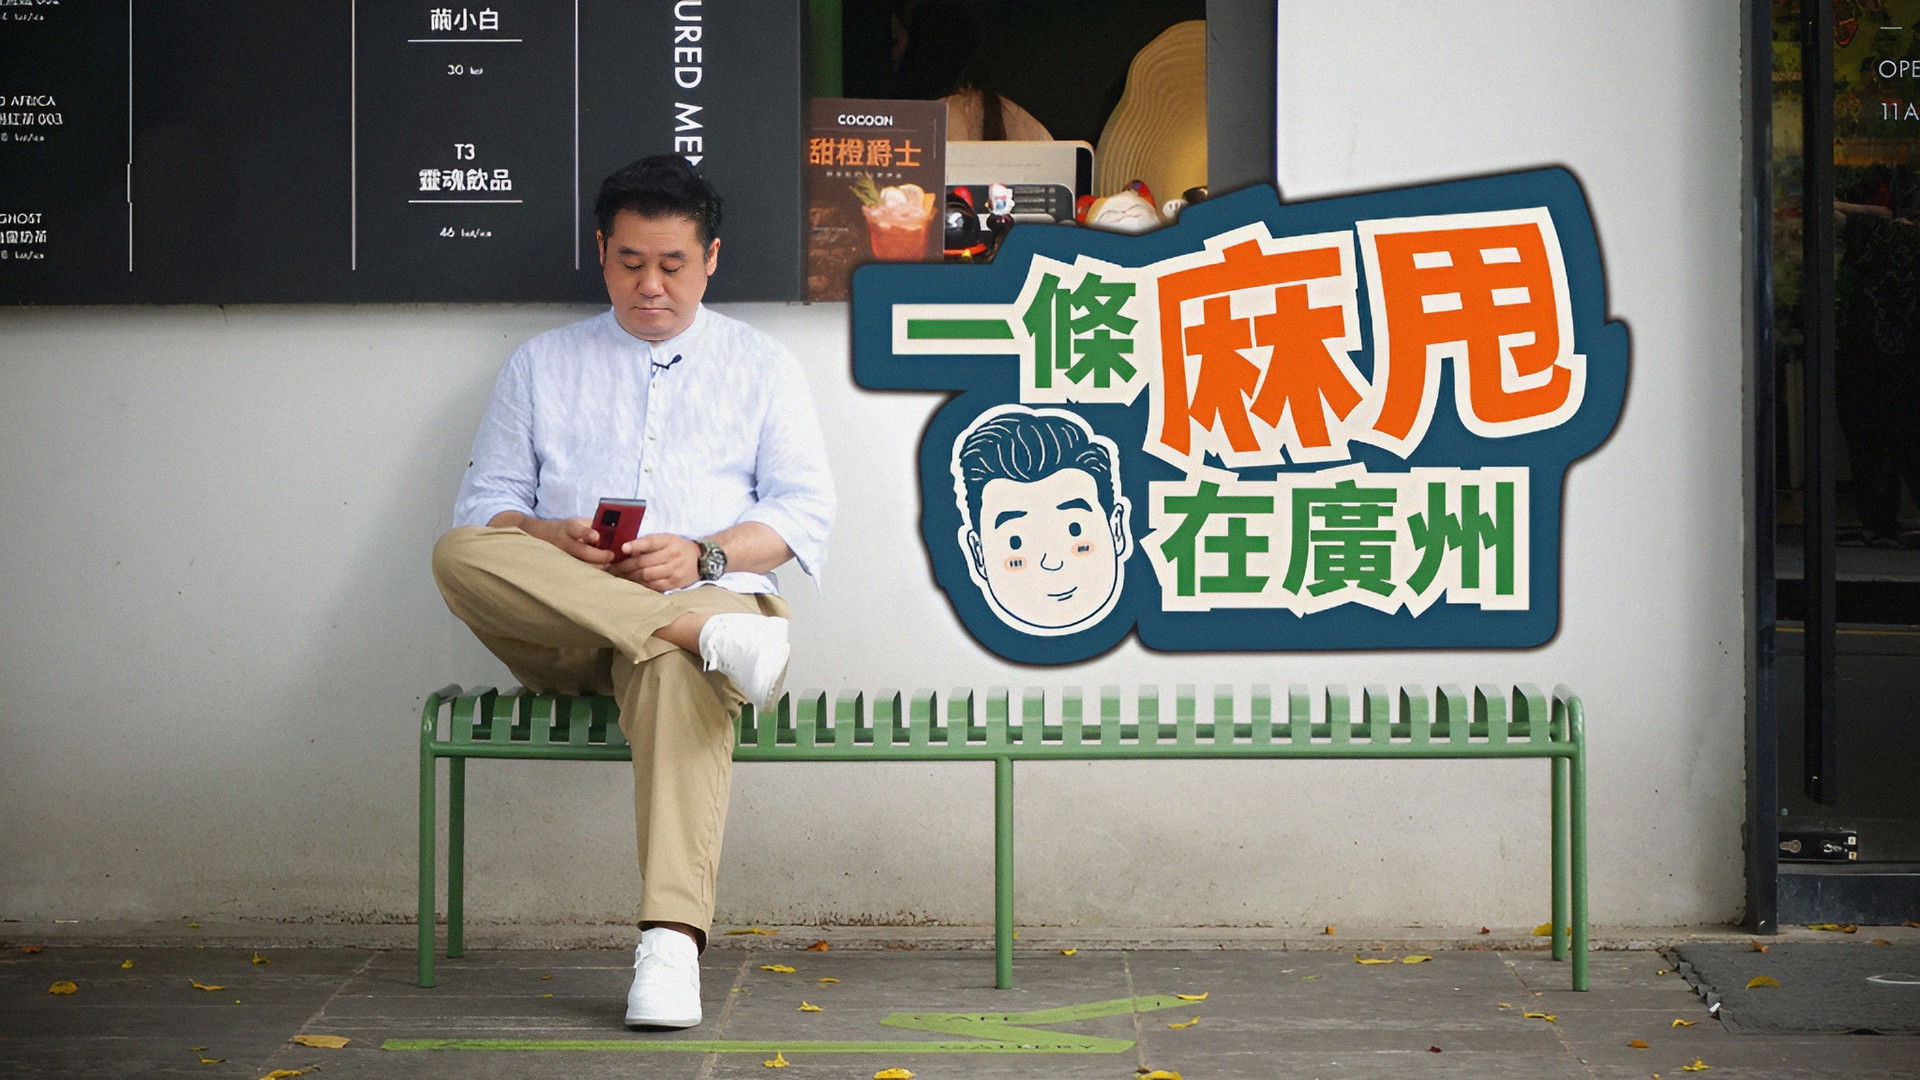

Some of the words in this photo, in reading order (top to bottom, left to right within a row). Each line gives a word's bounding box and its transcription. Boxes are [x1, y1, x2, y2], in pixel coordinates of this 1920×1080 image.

[837, 114, 893, 126] COCOON
[454, 143, 476, 160] T3
[809, 137, 922, 167] 甜橙爵士
